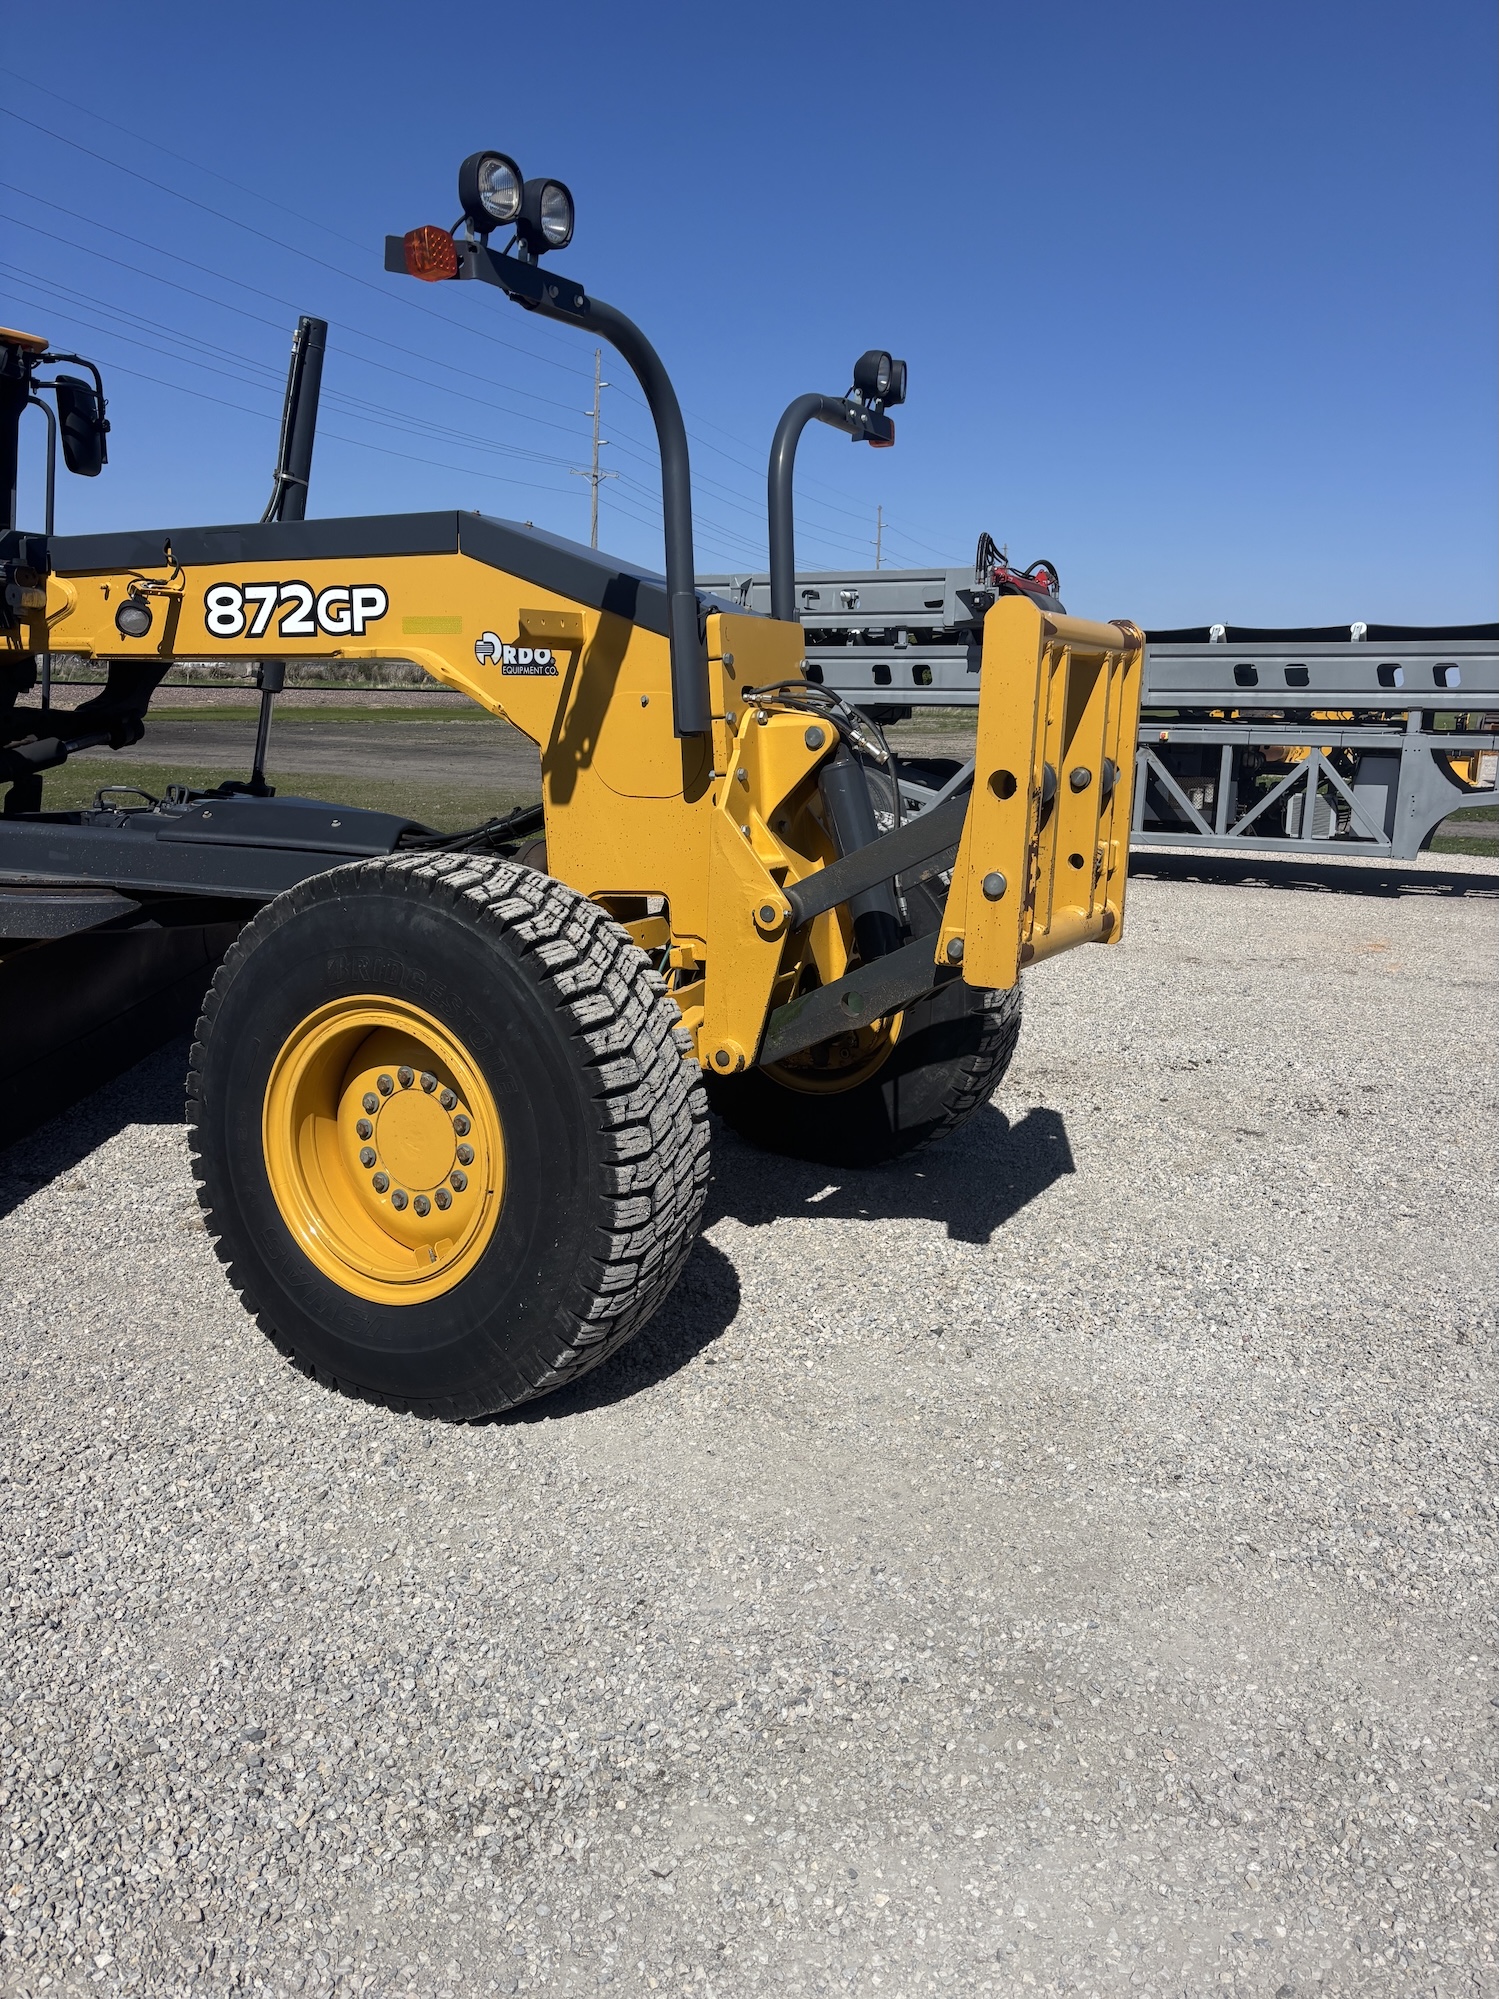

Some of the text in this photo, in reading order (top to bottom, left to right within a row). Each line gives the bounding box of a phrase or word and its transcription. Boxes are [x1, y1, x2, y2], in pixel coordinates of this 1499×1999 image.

[204, 581, 388, 637] 872GP
[502, 666, 558, 675] EQUIPMENT CO.
[326, 953, 519, 1095] BRIDGESTONE
